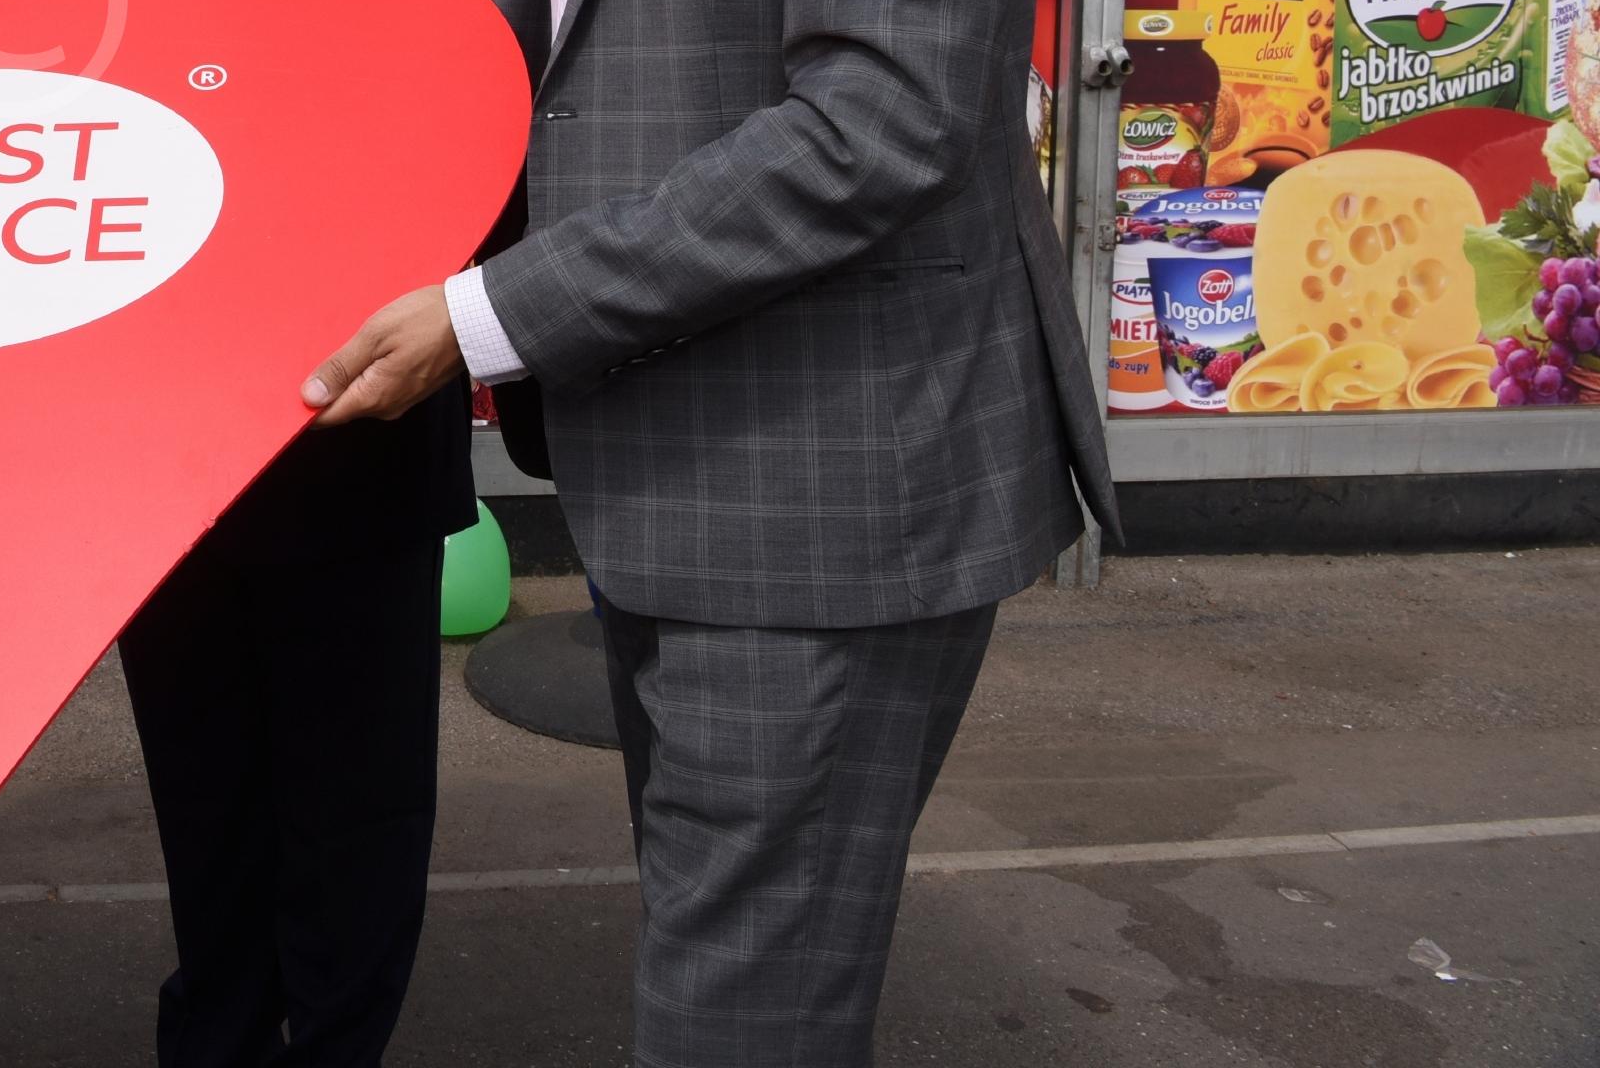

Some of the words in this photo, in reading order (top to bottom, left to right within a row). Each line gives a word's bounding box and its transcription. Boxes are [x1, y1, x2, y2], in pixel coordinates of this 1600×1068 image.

[1219, 2, 1290, 43] Family
[1256, 42, 1295, 62] classic
[1339, 46, 1431, 99] jabłko
[1361, 59, 1516, 124] brzoskwinia
[1124, 121, 1177, 137] ŁOWICZ
[1201, 279, 1233, 294] Zott
[1125, 362, 1149, 375] zupy
